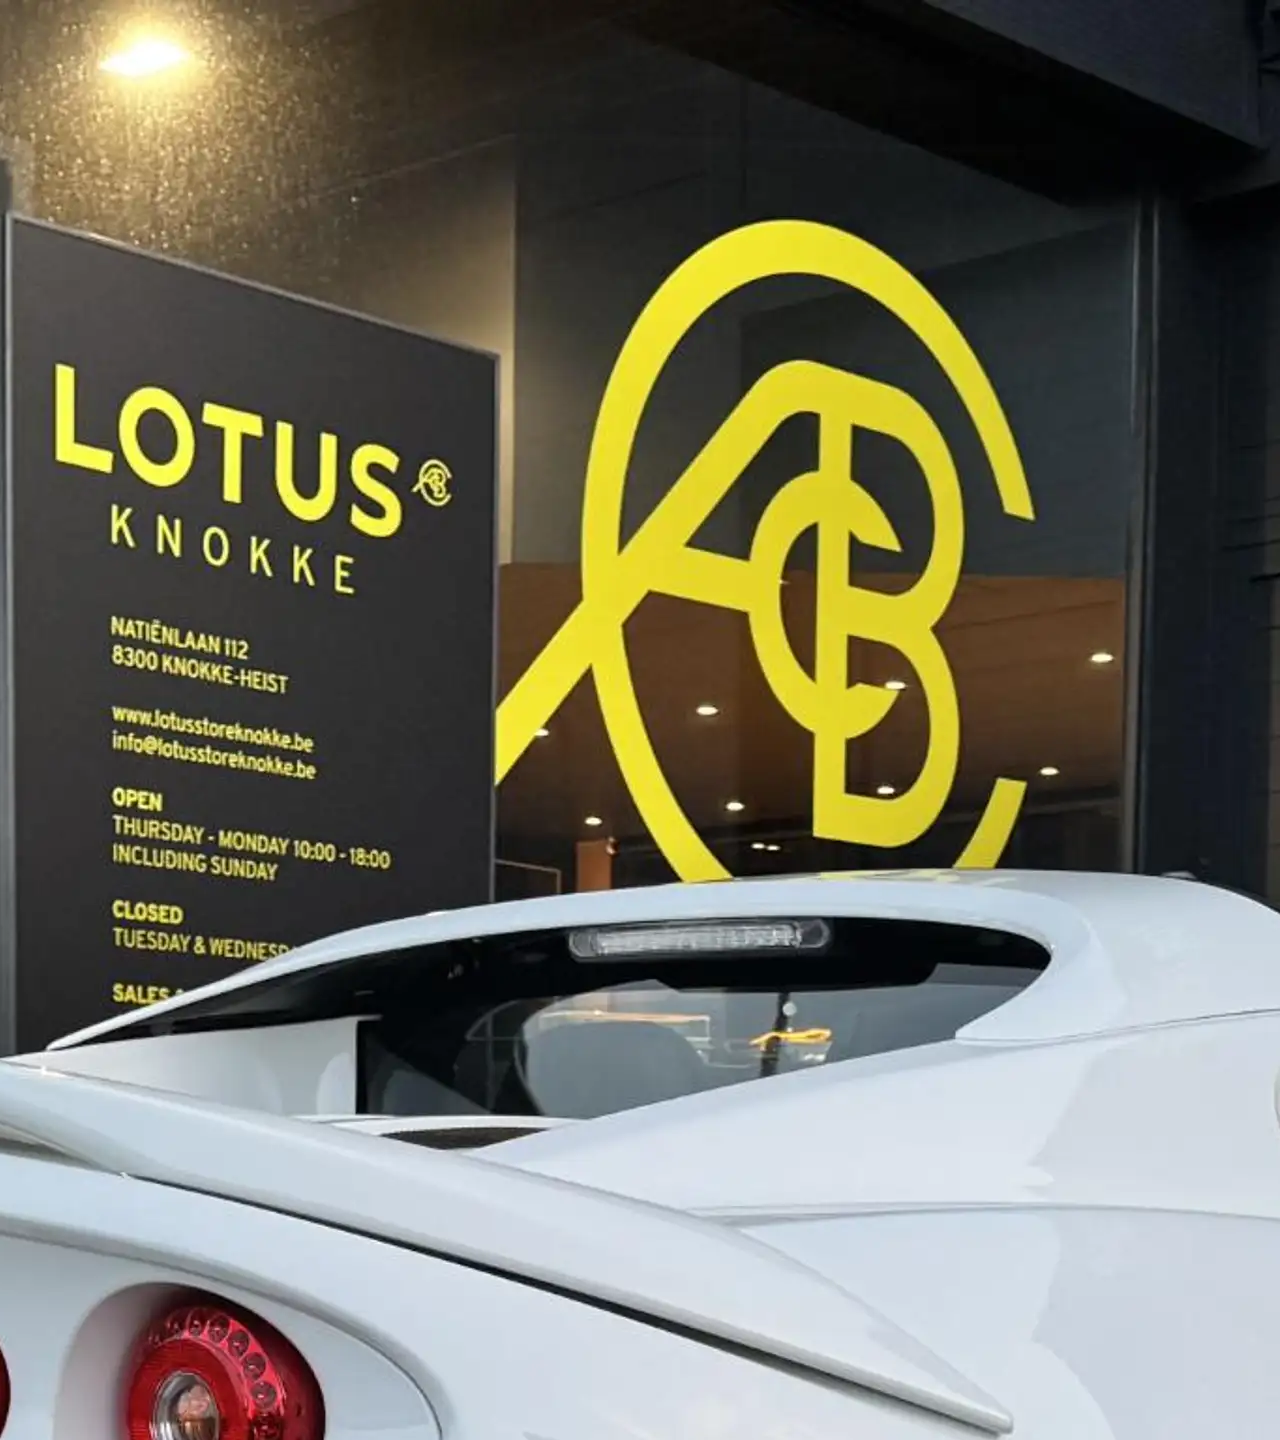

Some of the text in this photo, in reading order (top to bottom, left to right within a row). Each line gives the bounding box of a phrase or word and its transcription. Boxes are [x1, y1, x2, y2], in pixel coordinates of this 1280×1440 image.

[54, 362, 403, 538] LOTUS
[110, 503, 356, 594] KNOKKE
[111, 615, 249, 660] NATIËNLAAN 112
[112, 645, 289, 694] 8300 KNOKKE-HEIST
[112, 705, 314, 753] www.lotusstoreknokke.be
[112, 730, 317, 780] info@lotusstoreknokke.be
[112, 787, 163, 811] OPEN
[112, 815, 205, 844] THURSDAY
[218, 830, 289, 856] MONDAY
[293, 840, 336, 862] 10:00
[349, 847, 392, 869] 18:00
[112, 843, 278, 881] INCLUDING SUNDAY
[112, 899, 183, 925] CLOSED
[112, 927, 191, 953] TUESDAY
[193, 935, 206, 955] &
